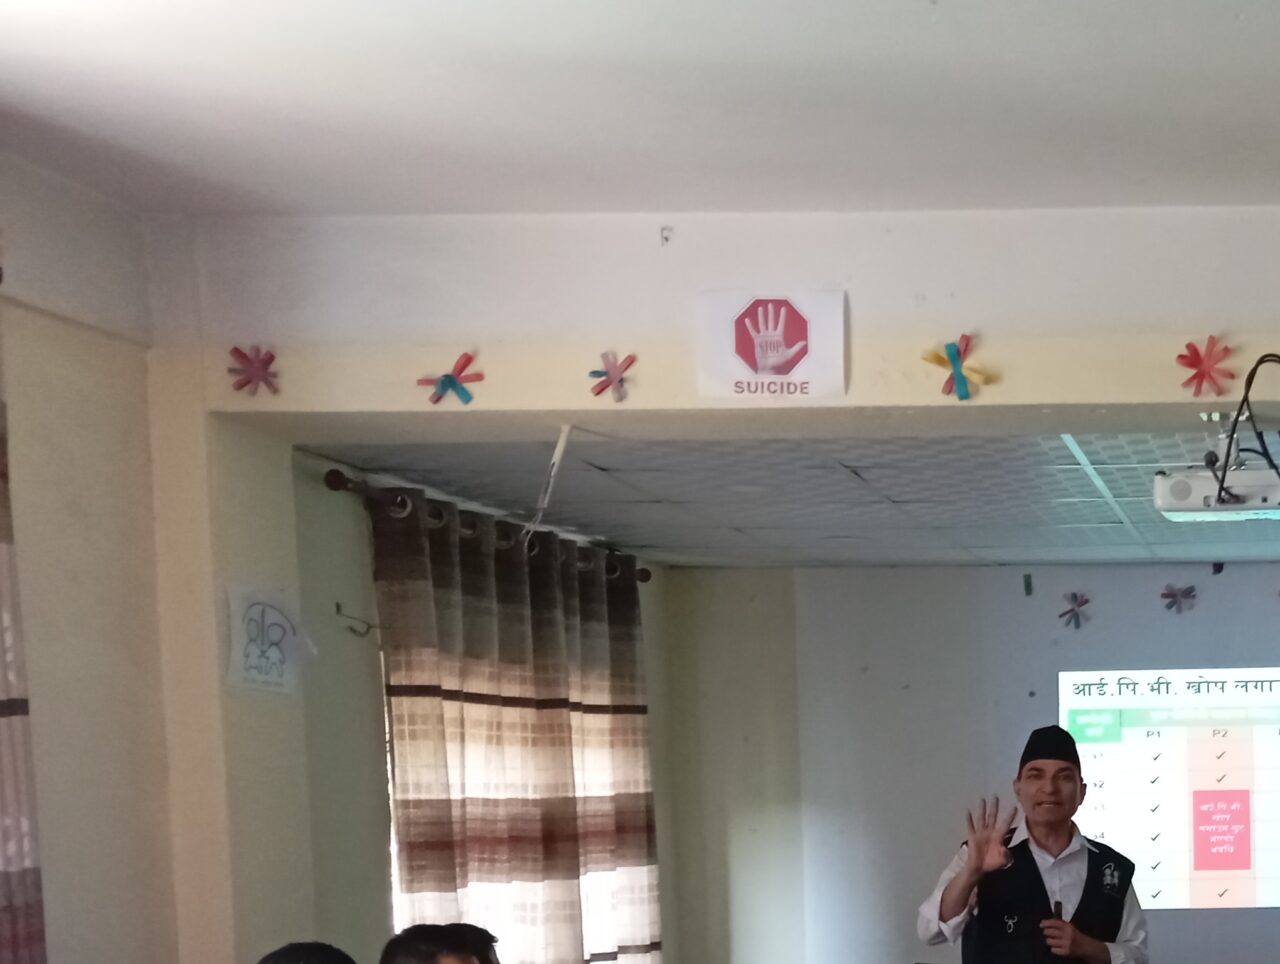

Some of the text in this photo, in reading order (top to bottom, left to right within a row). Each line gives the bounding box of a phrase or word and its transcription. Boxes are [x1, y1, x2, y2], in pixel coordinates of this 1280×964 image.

[734, 381, 809, 395] SUICIDE
[1185, 676, 1227, 694] खोप
[1146, 730, 1161, 739] P1
[1212, 729, 1228, 738] P2
